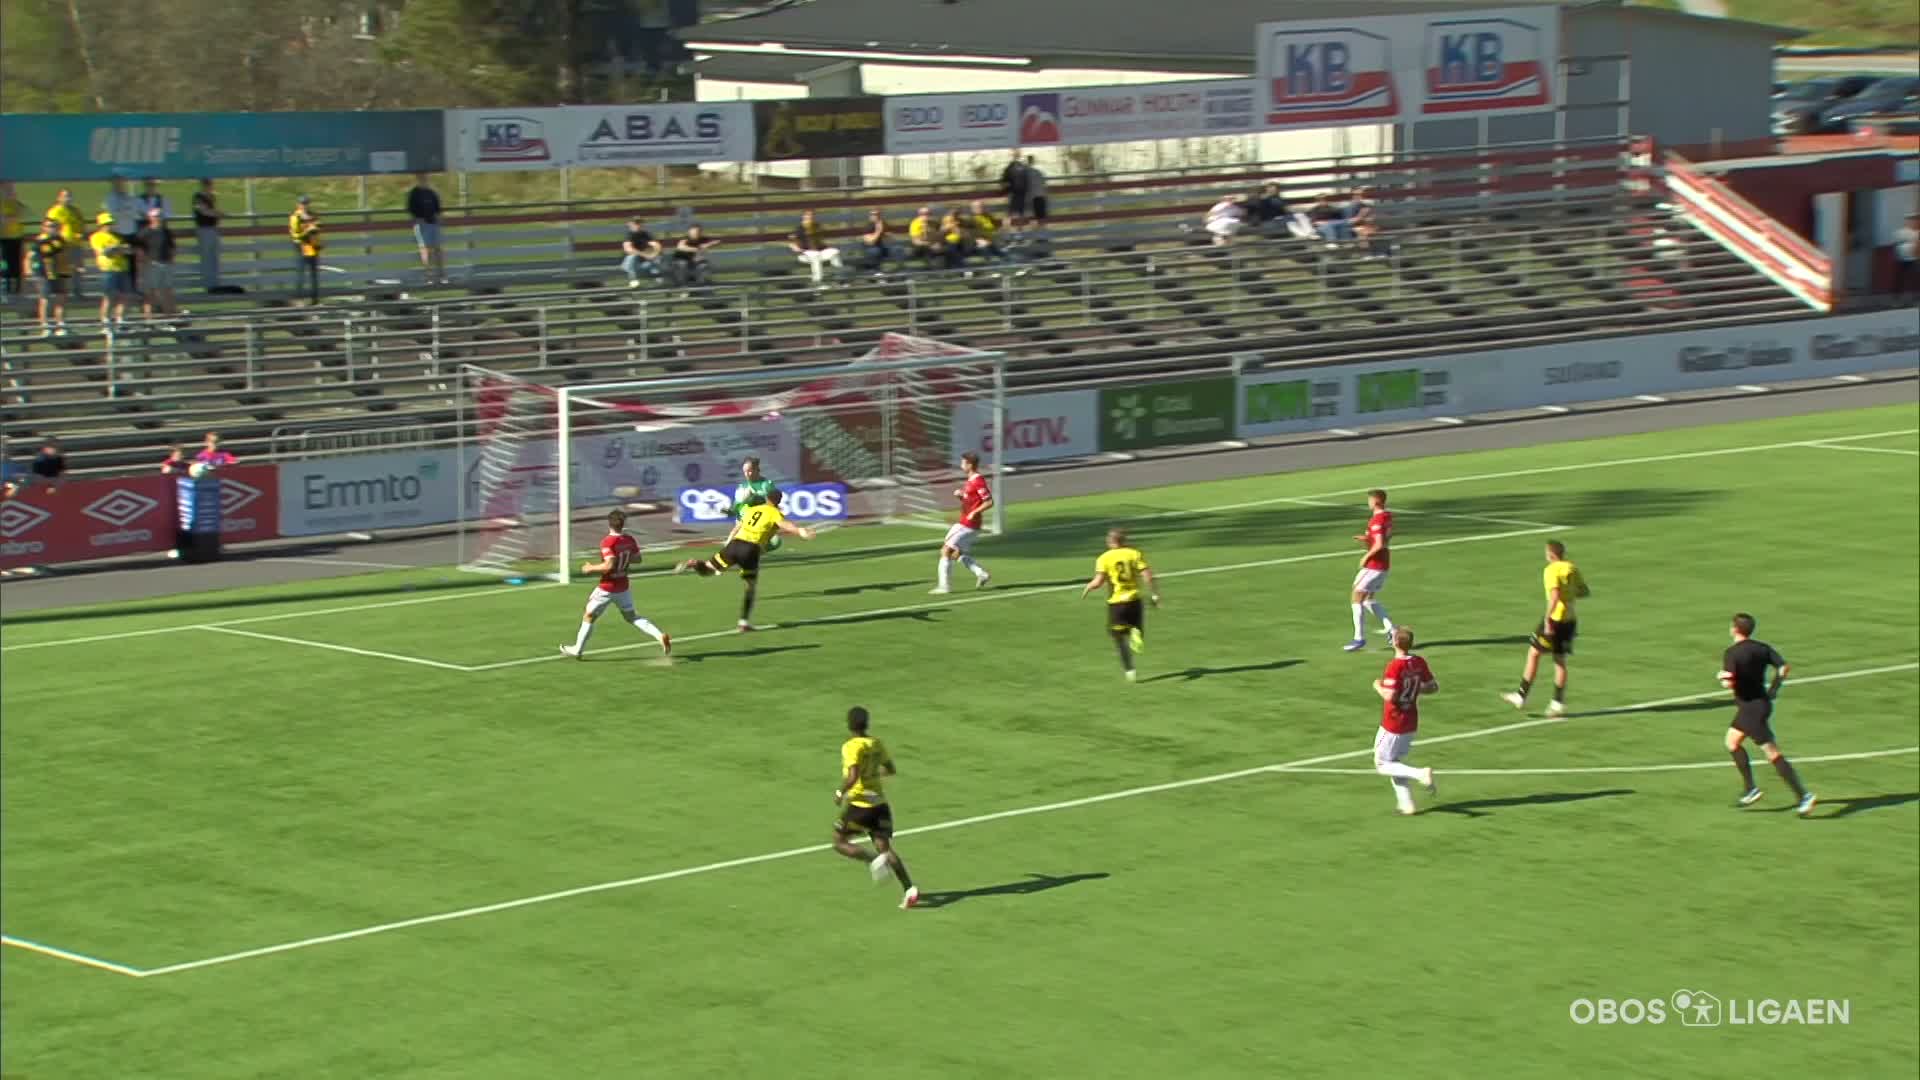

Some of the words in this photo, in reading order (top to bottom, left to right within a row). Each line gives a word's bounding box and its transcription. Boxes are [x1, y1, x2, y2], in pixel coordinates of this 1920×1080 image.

[1287, 42, 1350, 94] KB
[1439, 33, 1504, 86] KB
[486, 123, 521, 146] KB
[589, 113, 721, 141] ABAS
[1400, 674, 1422, 704] 27
